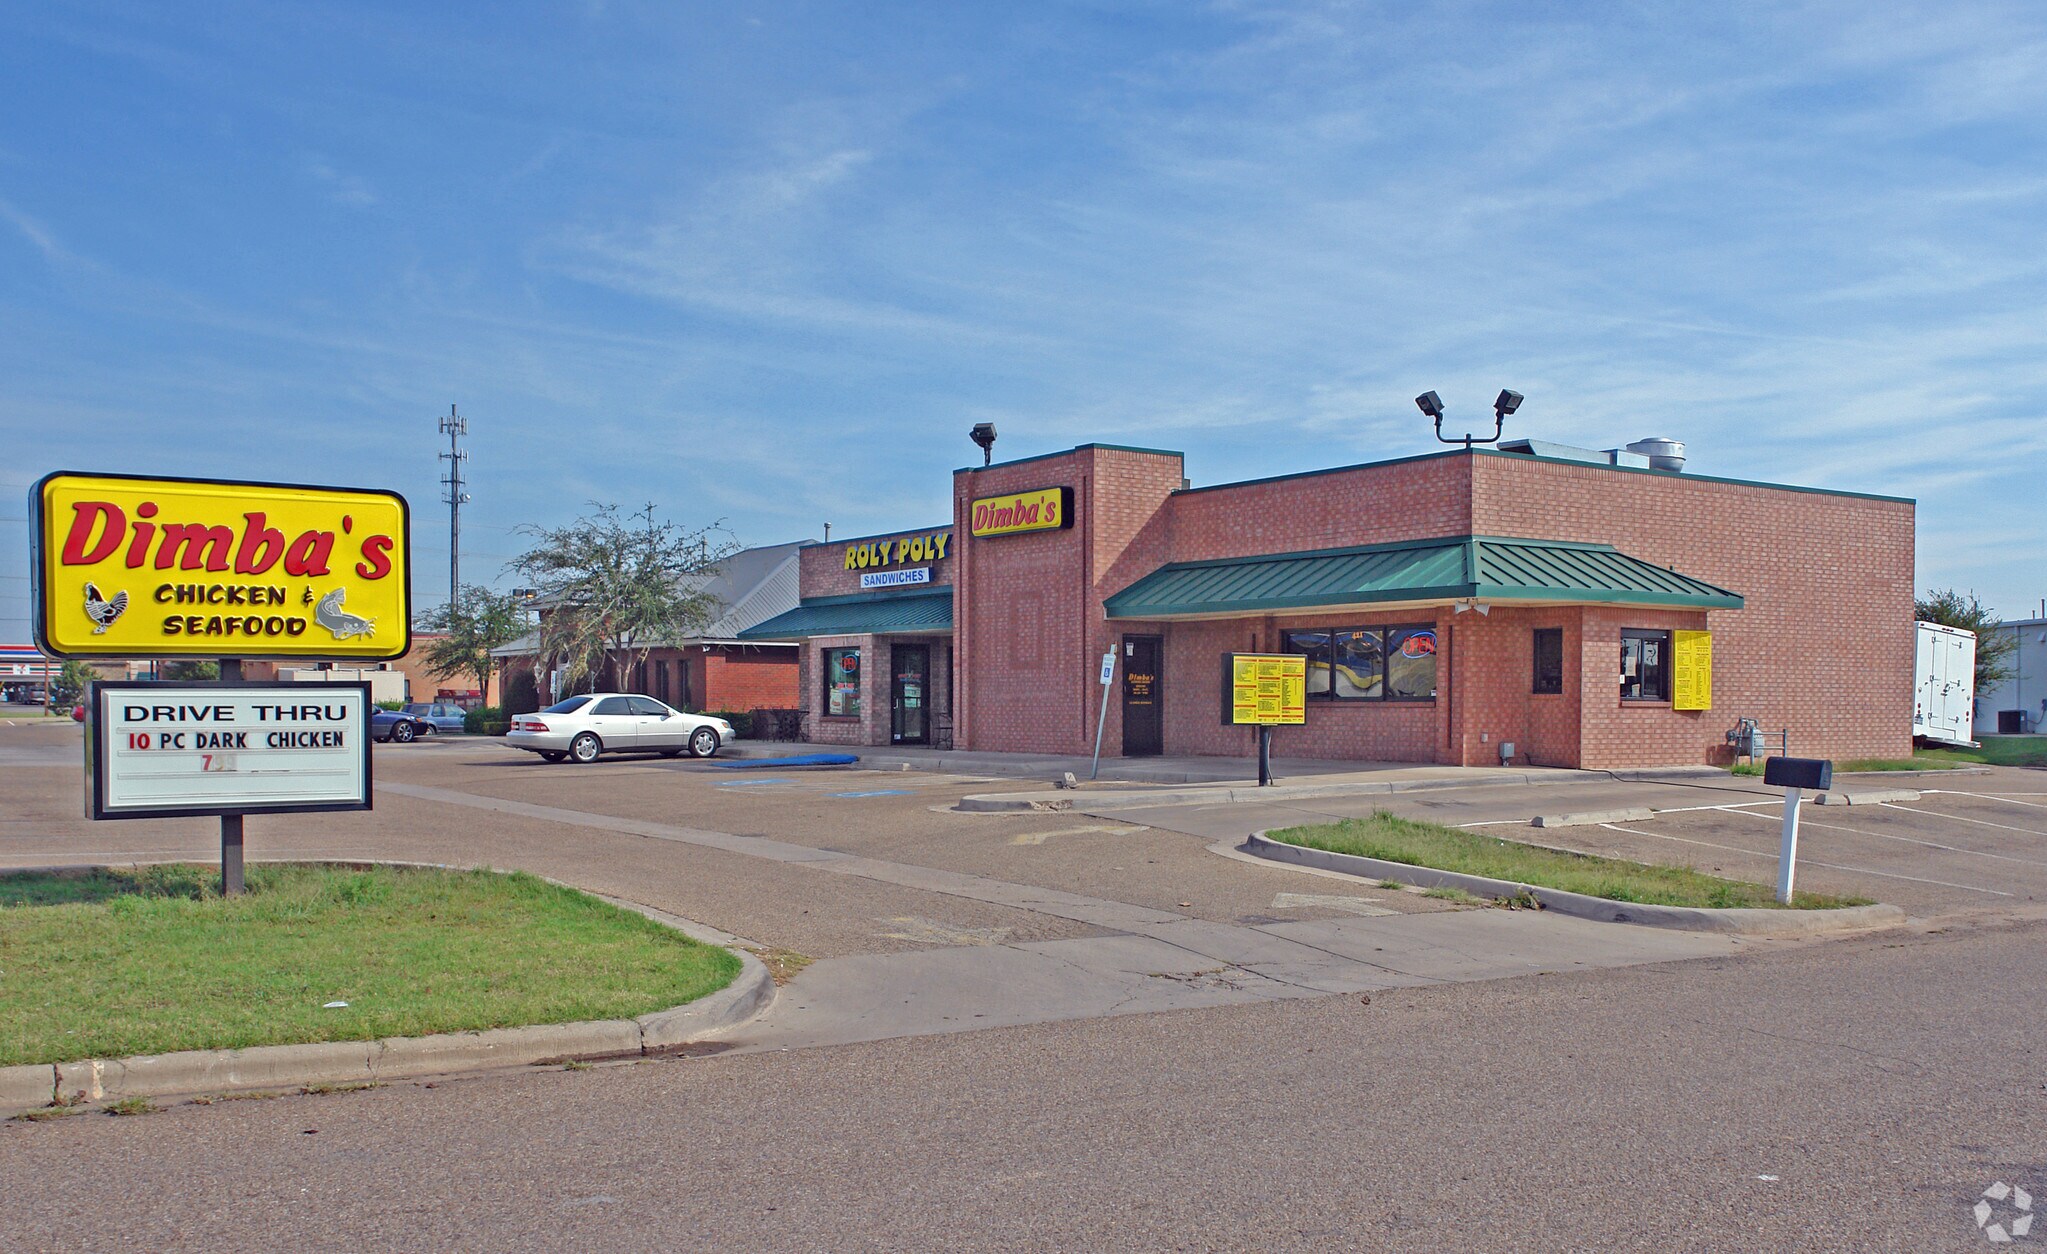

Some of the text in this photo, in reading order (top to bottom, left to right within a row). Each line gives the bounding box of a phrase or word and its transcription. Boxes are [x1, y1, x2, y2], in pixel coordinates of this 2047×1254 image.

[973, 496, 1056, 531] Dimba's
[62, 501, 394, 580] Dimba's
[844, 533, 949, 570] ROLY POLY
[864, 570, 924, 586] SANDWICHES
[155, 583, 315, 607] CHICKEN &
[163, 615, 307, 636] SEAFOOD
[1402, 637, 1435, 654] OPEN
[123, 705, 347, 721] DRIVE THRU
[128, 731, 344, 749] 10 PC DARK CHICKEN
